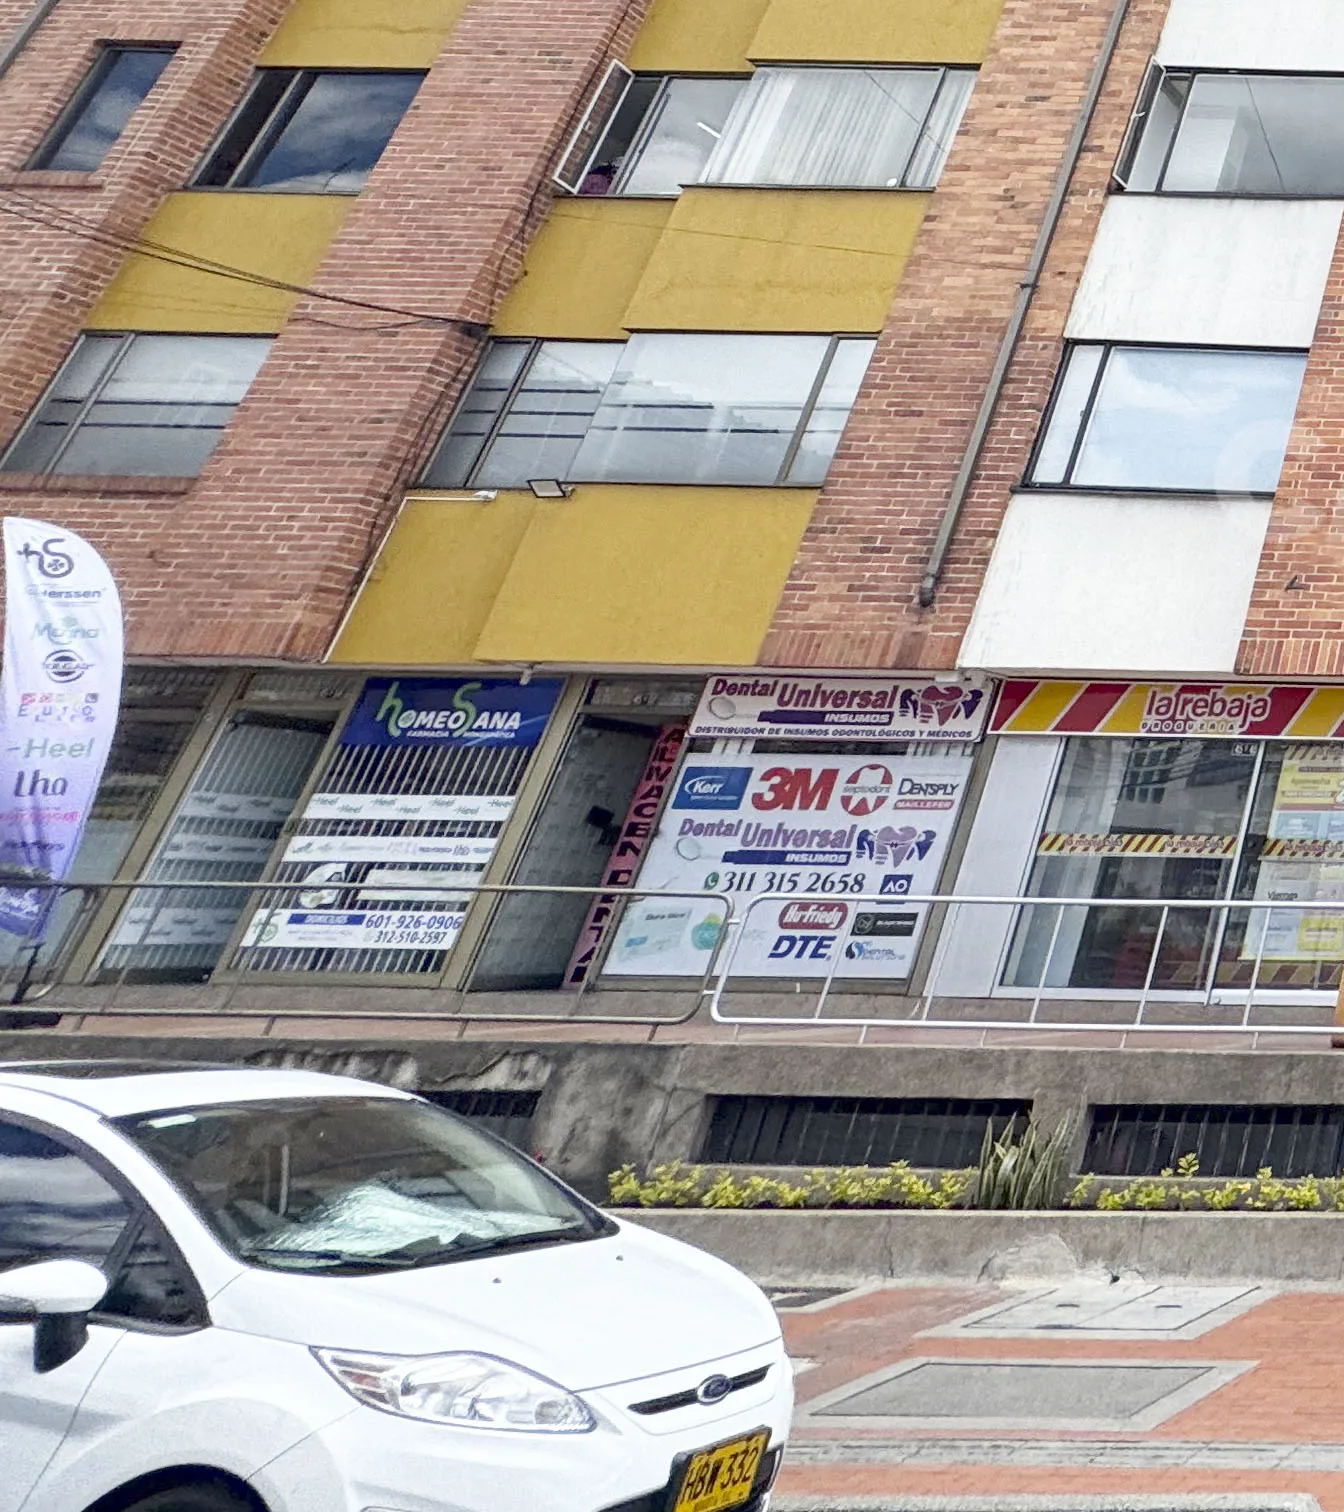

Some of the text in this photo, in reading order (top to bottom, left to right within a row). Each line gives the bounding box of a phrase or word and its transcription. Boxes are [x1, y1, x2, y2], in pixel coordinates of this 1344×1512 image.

[711, 678, 898, 710] Dental Universal
[824, 713, 890, 724] INSUMOS
[1146, 689, 1270, 729] la rebaja
[695, 726, 766, 735] DISTRIBUIDOR
[768, 728, 781, 736] DE
[783, 728, 830, 737] INSUMOS
[918, 730, 925, 738] Y
[693, 780, 725, 794] Kerr
[751, 767, 840, 810] 3M
[678, 818, 857, 849] Dental Universal
[785, 852, 848, 864] INSUMOS
[720, 872, 867, 894] 311 315 2658
[768, 935, 838, 959] DTE
[720, 1446, 759, 1489] 332
